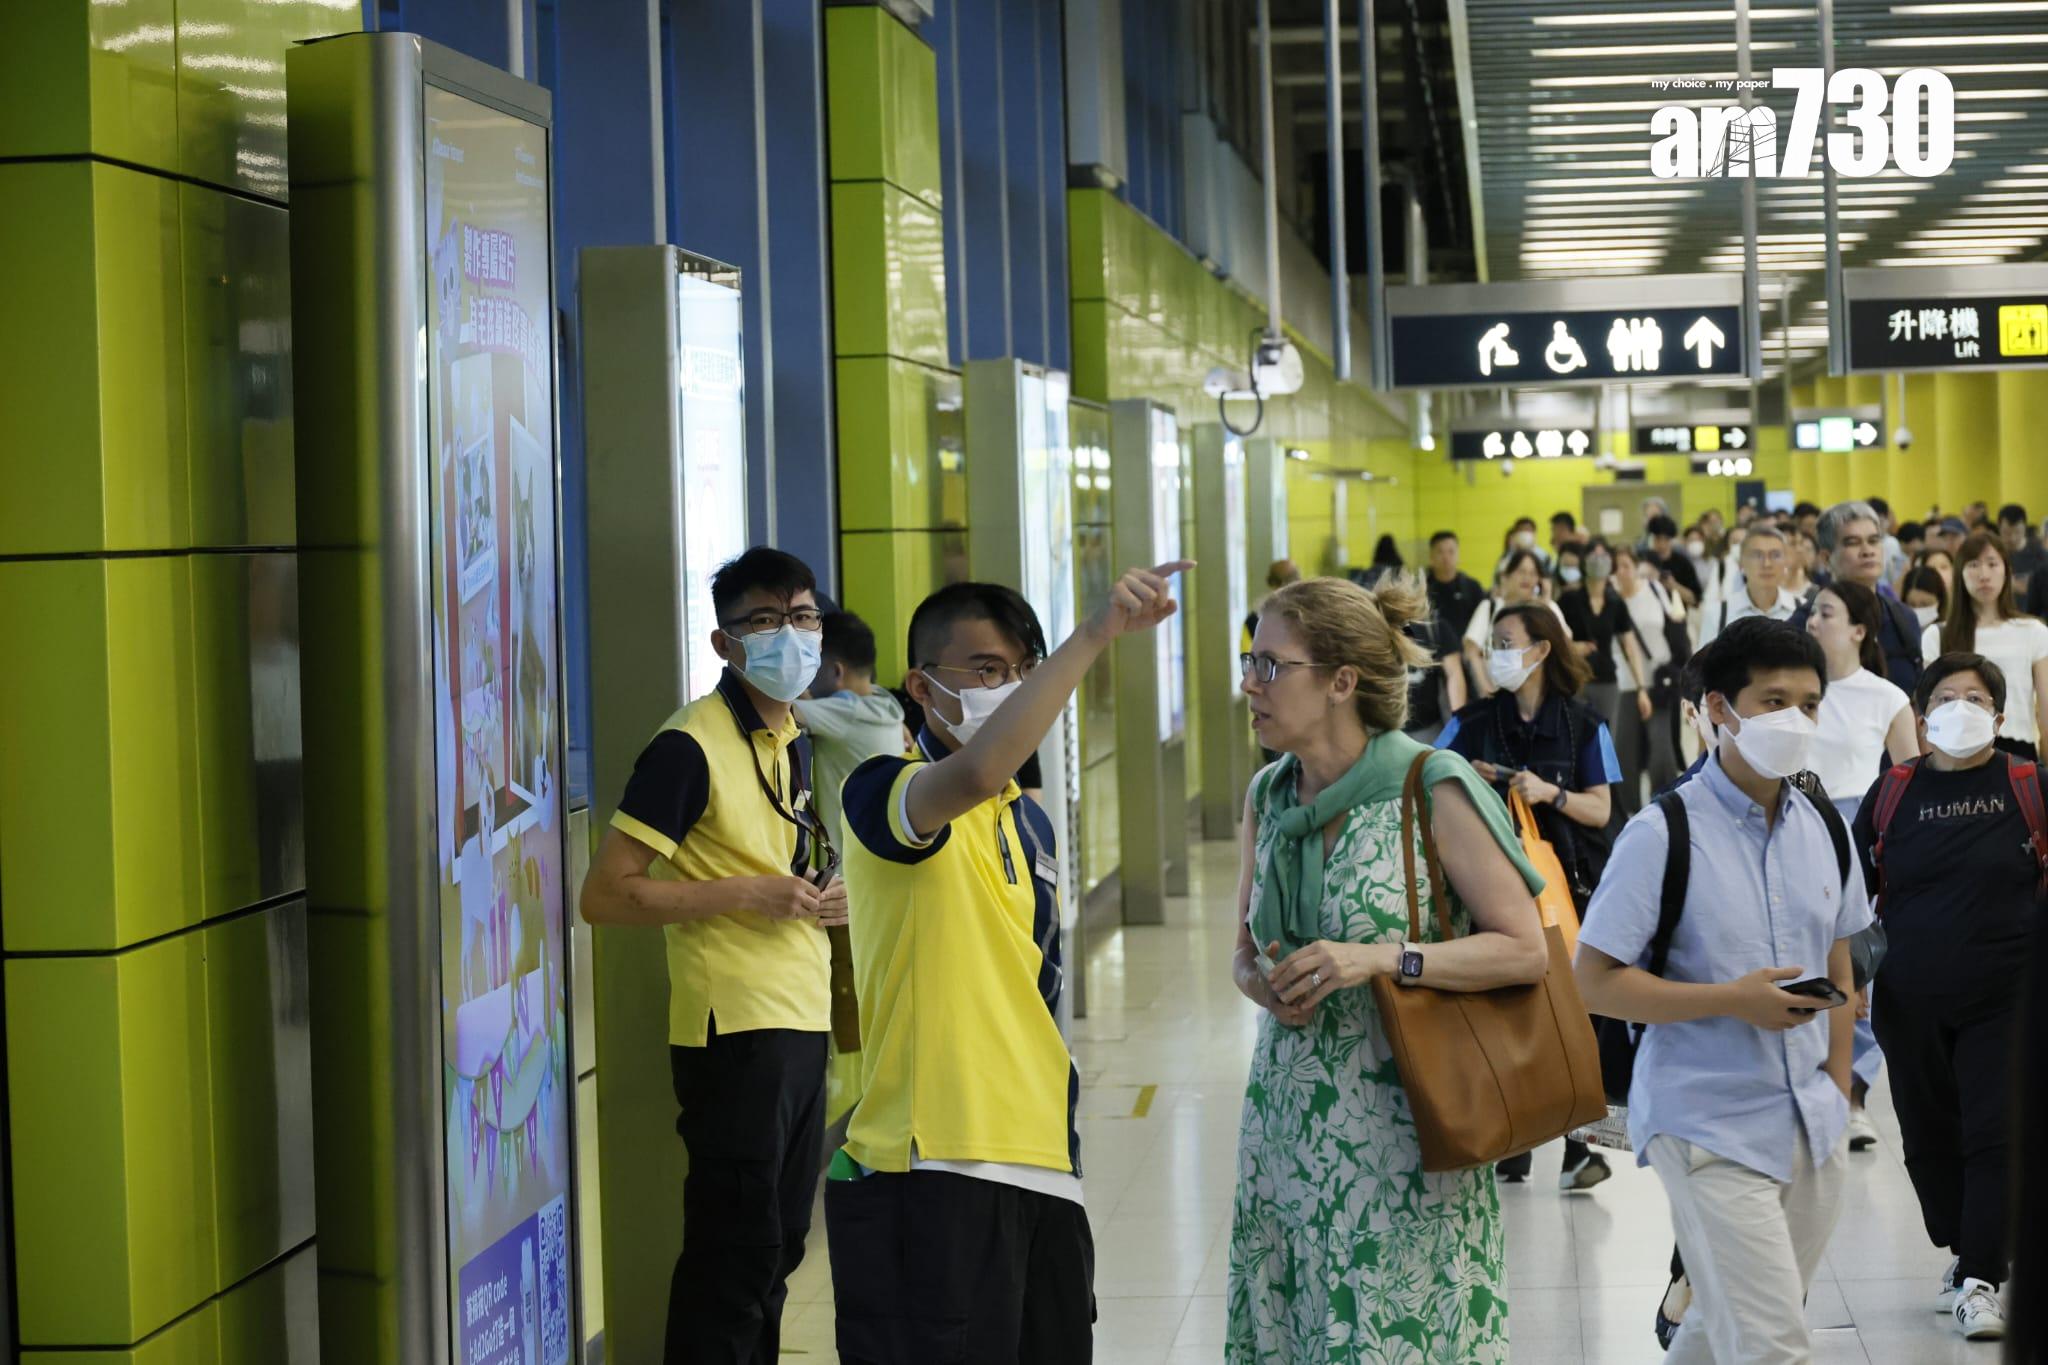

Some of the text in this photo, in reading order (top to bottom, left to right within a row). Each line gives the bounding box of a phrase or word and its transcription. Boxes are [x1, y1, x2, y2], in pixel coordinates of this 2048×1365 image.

[1888, 307, 1980, 341] 升降機
[1954, 340, 1980, 358] Lift
[1919, 796, 2005, 821] HUMAN
[493, 1270, 508, 1304] code
